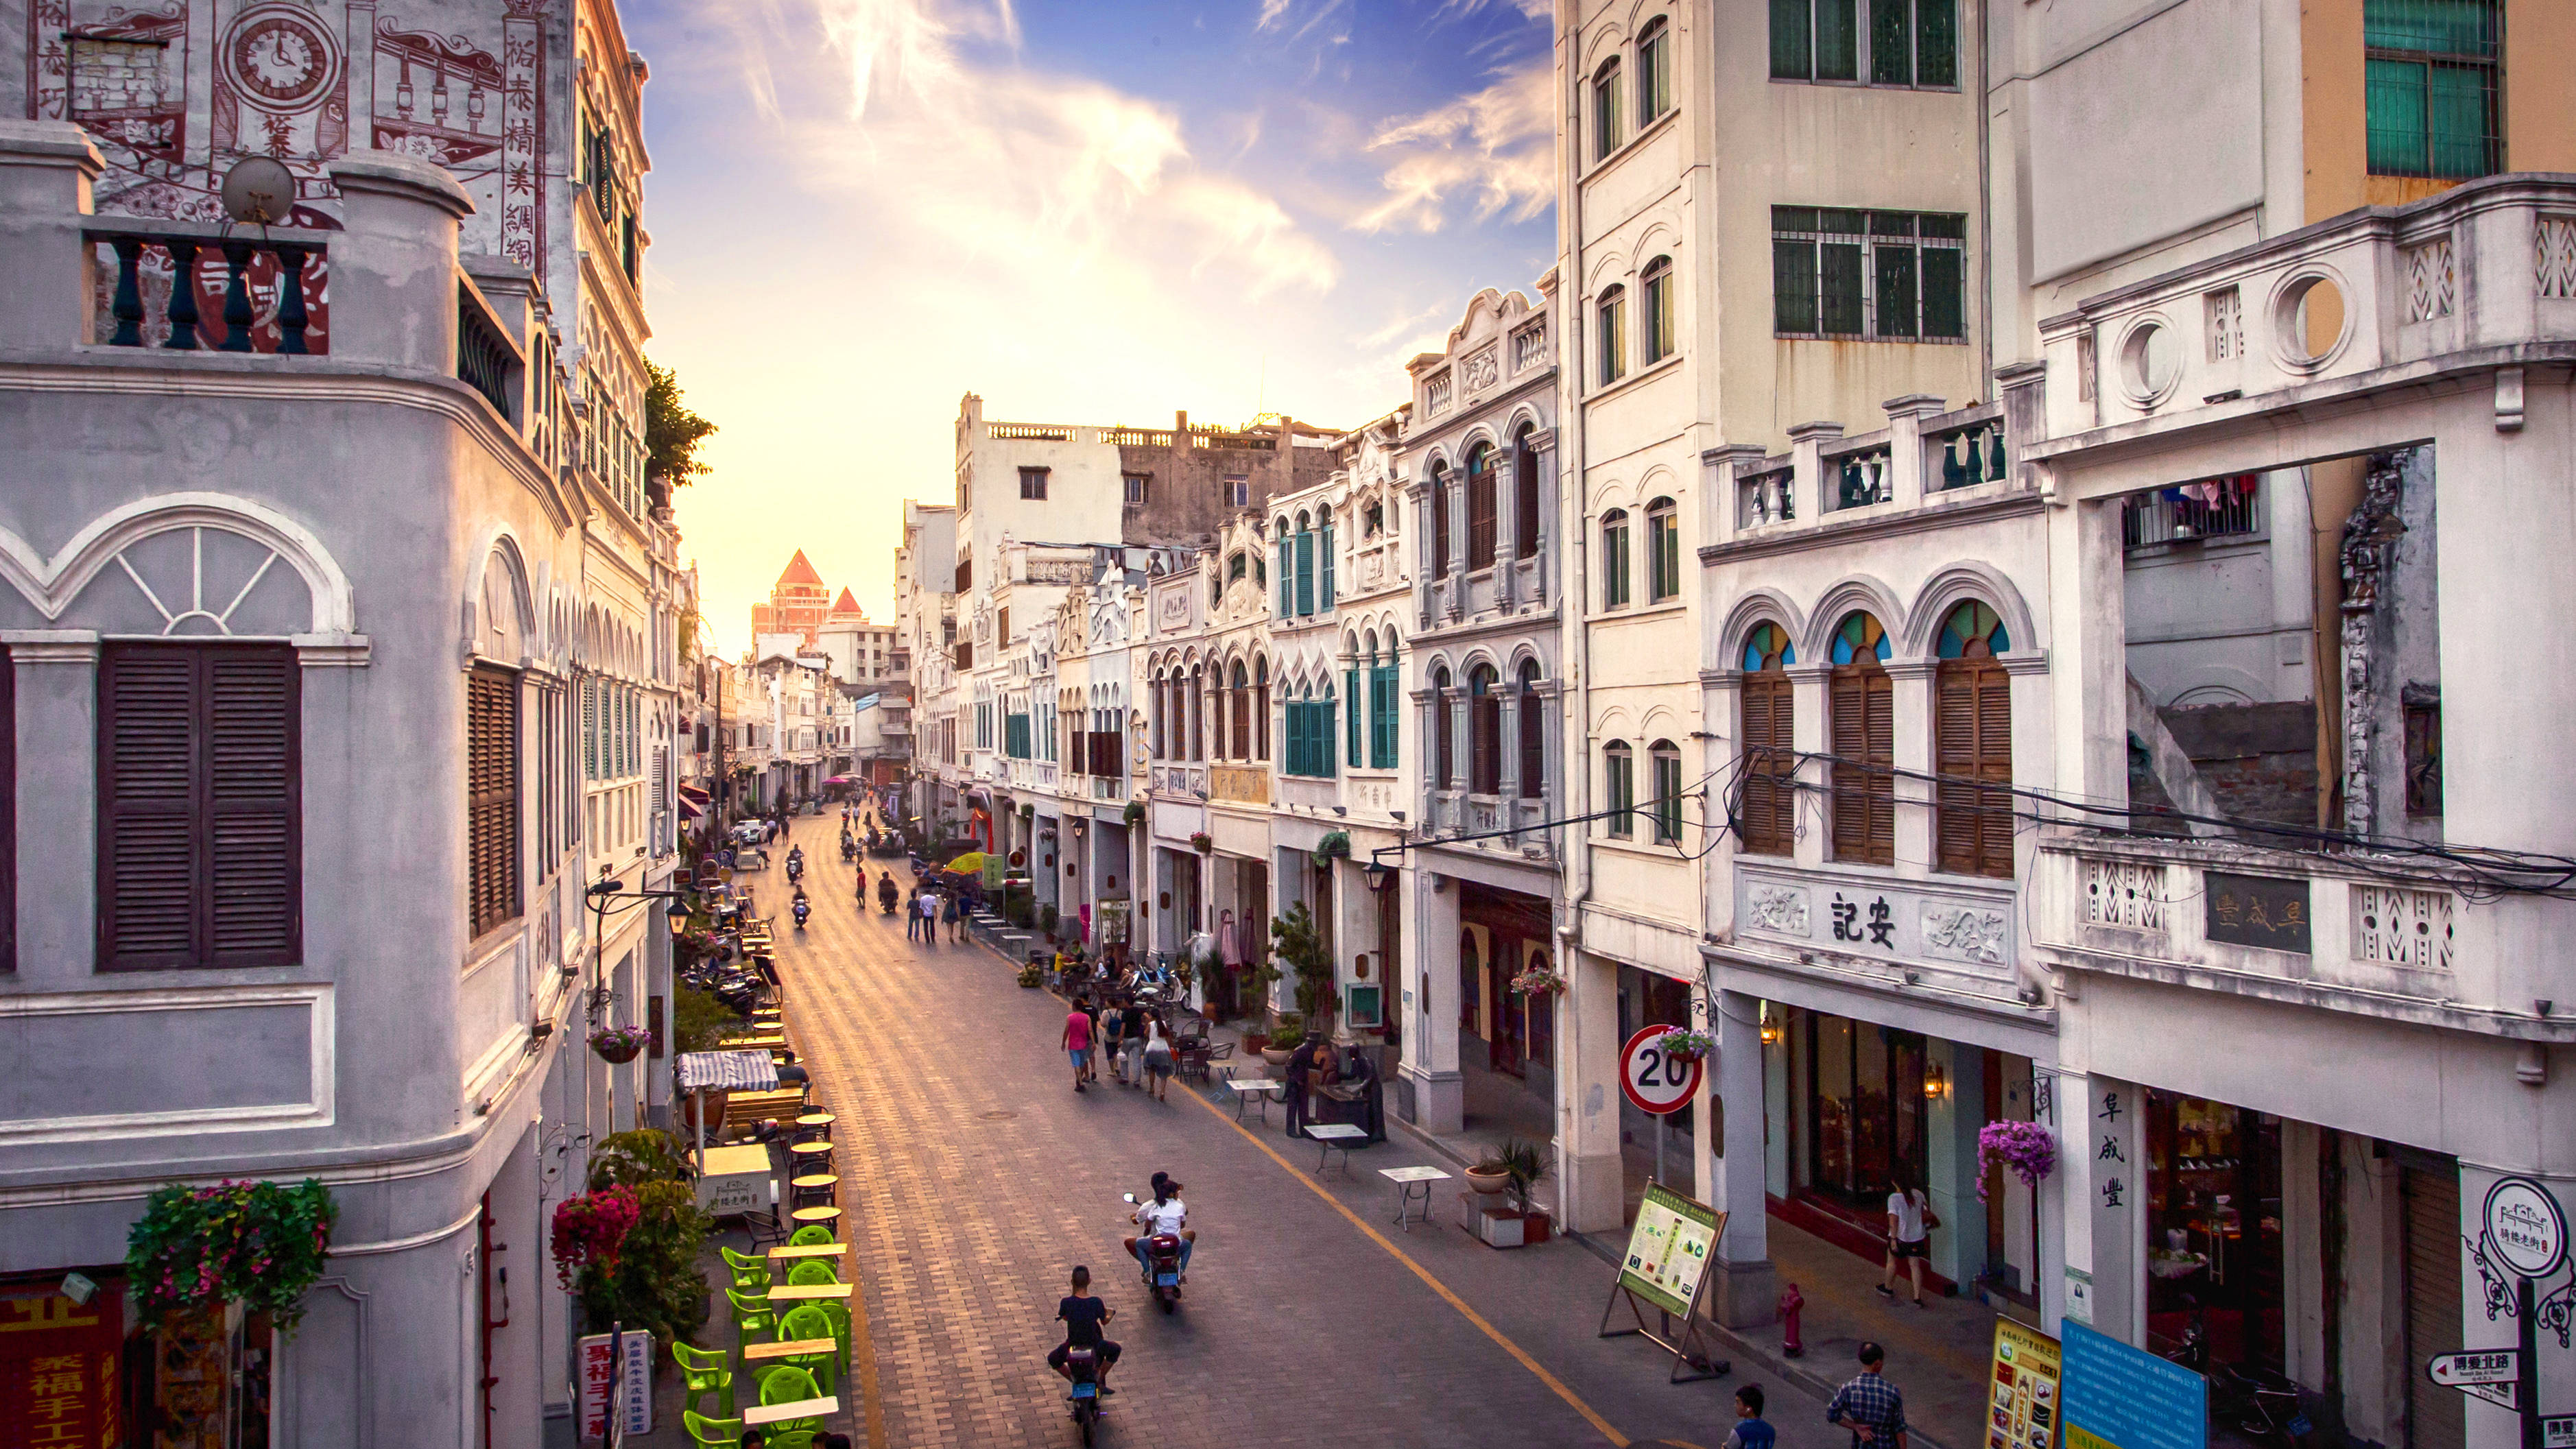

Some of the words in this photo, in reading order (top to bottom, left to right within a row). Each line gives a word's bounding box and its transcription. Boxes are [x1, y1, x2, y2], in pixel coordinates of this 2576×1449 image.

[261, 115, 298, 160] 裕泰
[1638, 1048, 1689, 1088] 20
[2098, 1092, 2125, 1208] 阜成豐
[2454, 1354, 2508, 1370] 博爱北路
[2548, 1420, 2576, 1435] 博爱
